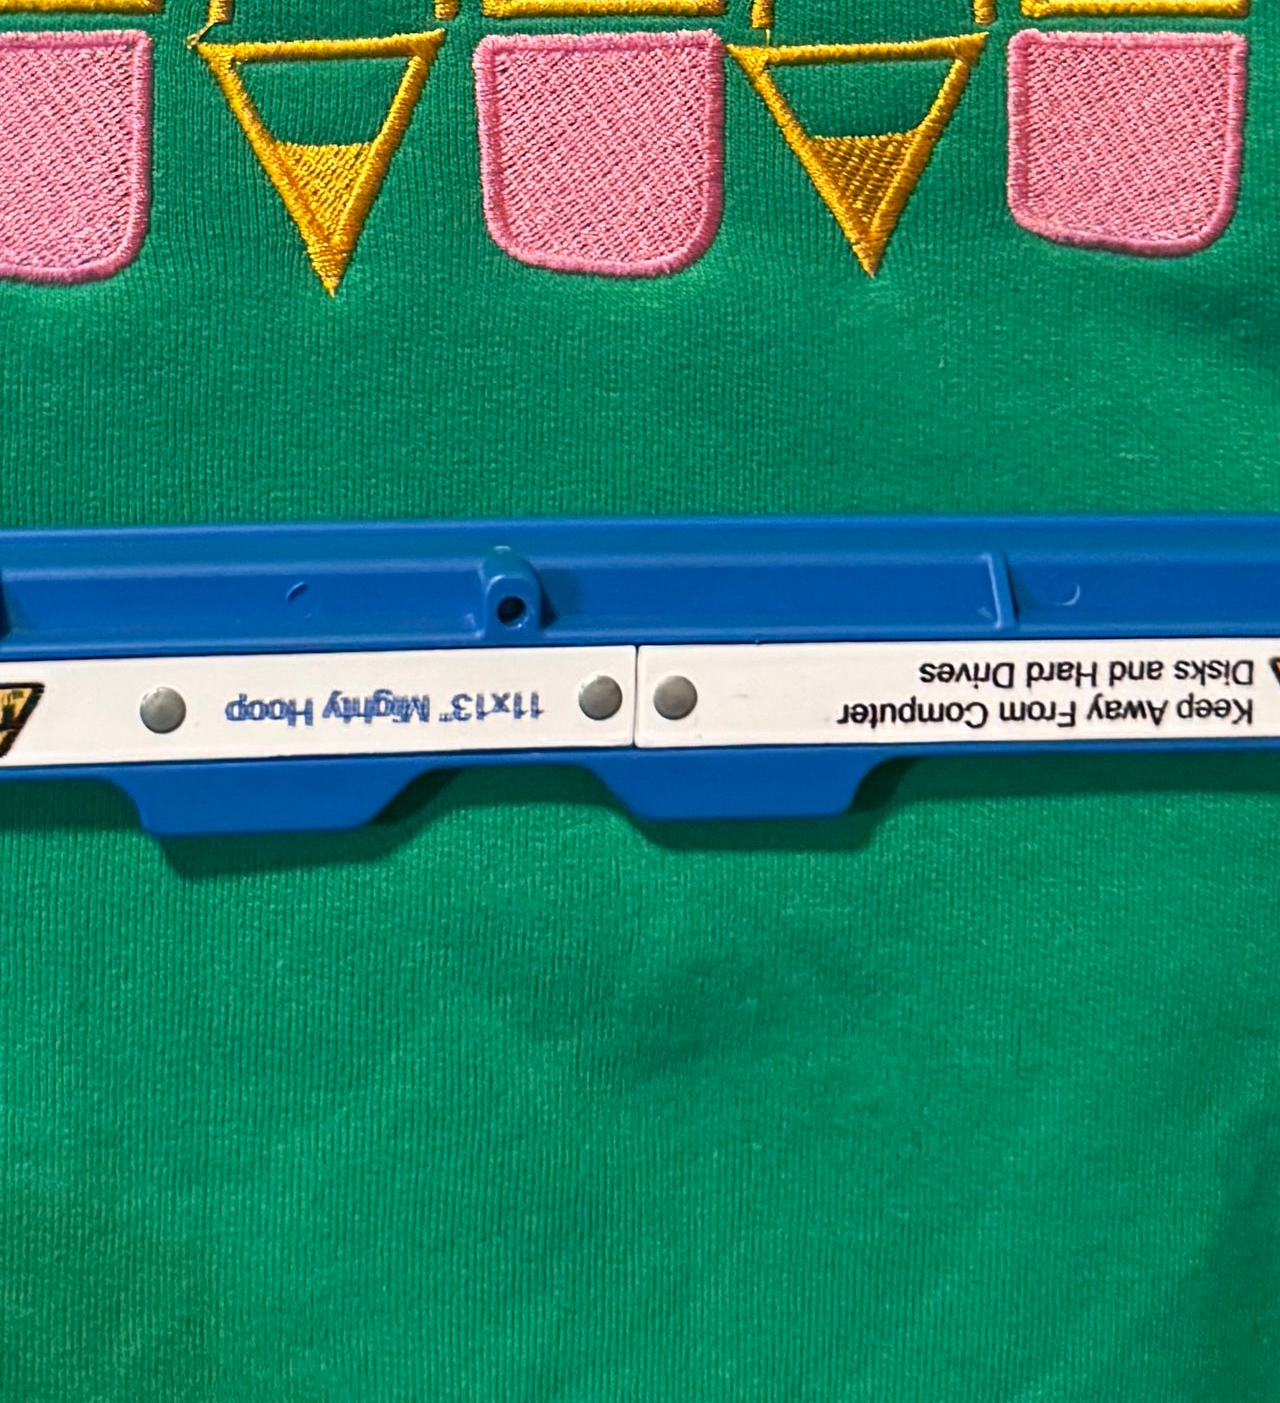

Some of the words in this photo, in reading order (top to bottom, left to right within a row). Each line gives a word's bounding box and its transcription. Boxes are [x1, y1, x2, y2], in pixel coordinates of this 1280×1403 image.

[917, 661, 1016, 691] Drives
[1026, 660, 1099, 690] Hard
[1108, 659, 1166, 689] and
[1173, 659, 1256, 687] Disks
[223, 692, 315, 727] Hoop
[321, 688, 432, 724] Mighty
[438, 692, 545, 723] 11x13"
[835, 695, 990, 731] Computer
[999, 699, 1078, 728] From
[1086, 692, 1170, 728] Away
[1176, 692, 1255, 726] Keep
